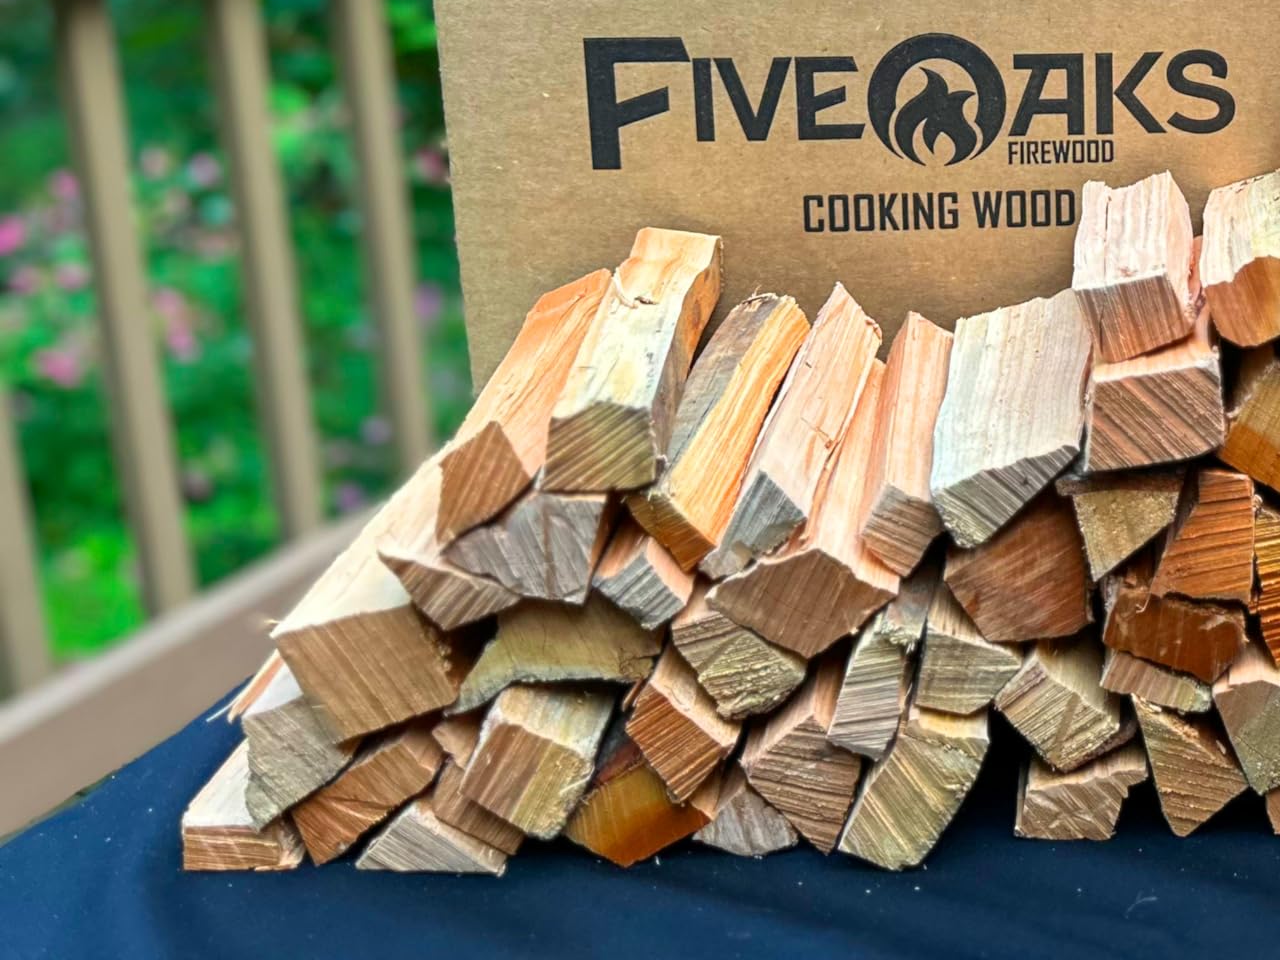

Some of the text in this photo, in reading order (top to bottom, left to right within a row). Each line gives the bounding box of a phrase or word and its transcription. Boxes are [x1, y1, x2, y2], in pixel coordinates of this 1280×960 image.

[1007, 139, 1115, 166] FIREWOOD
[802, 188, 1077, 234] COOKING WOOD
